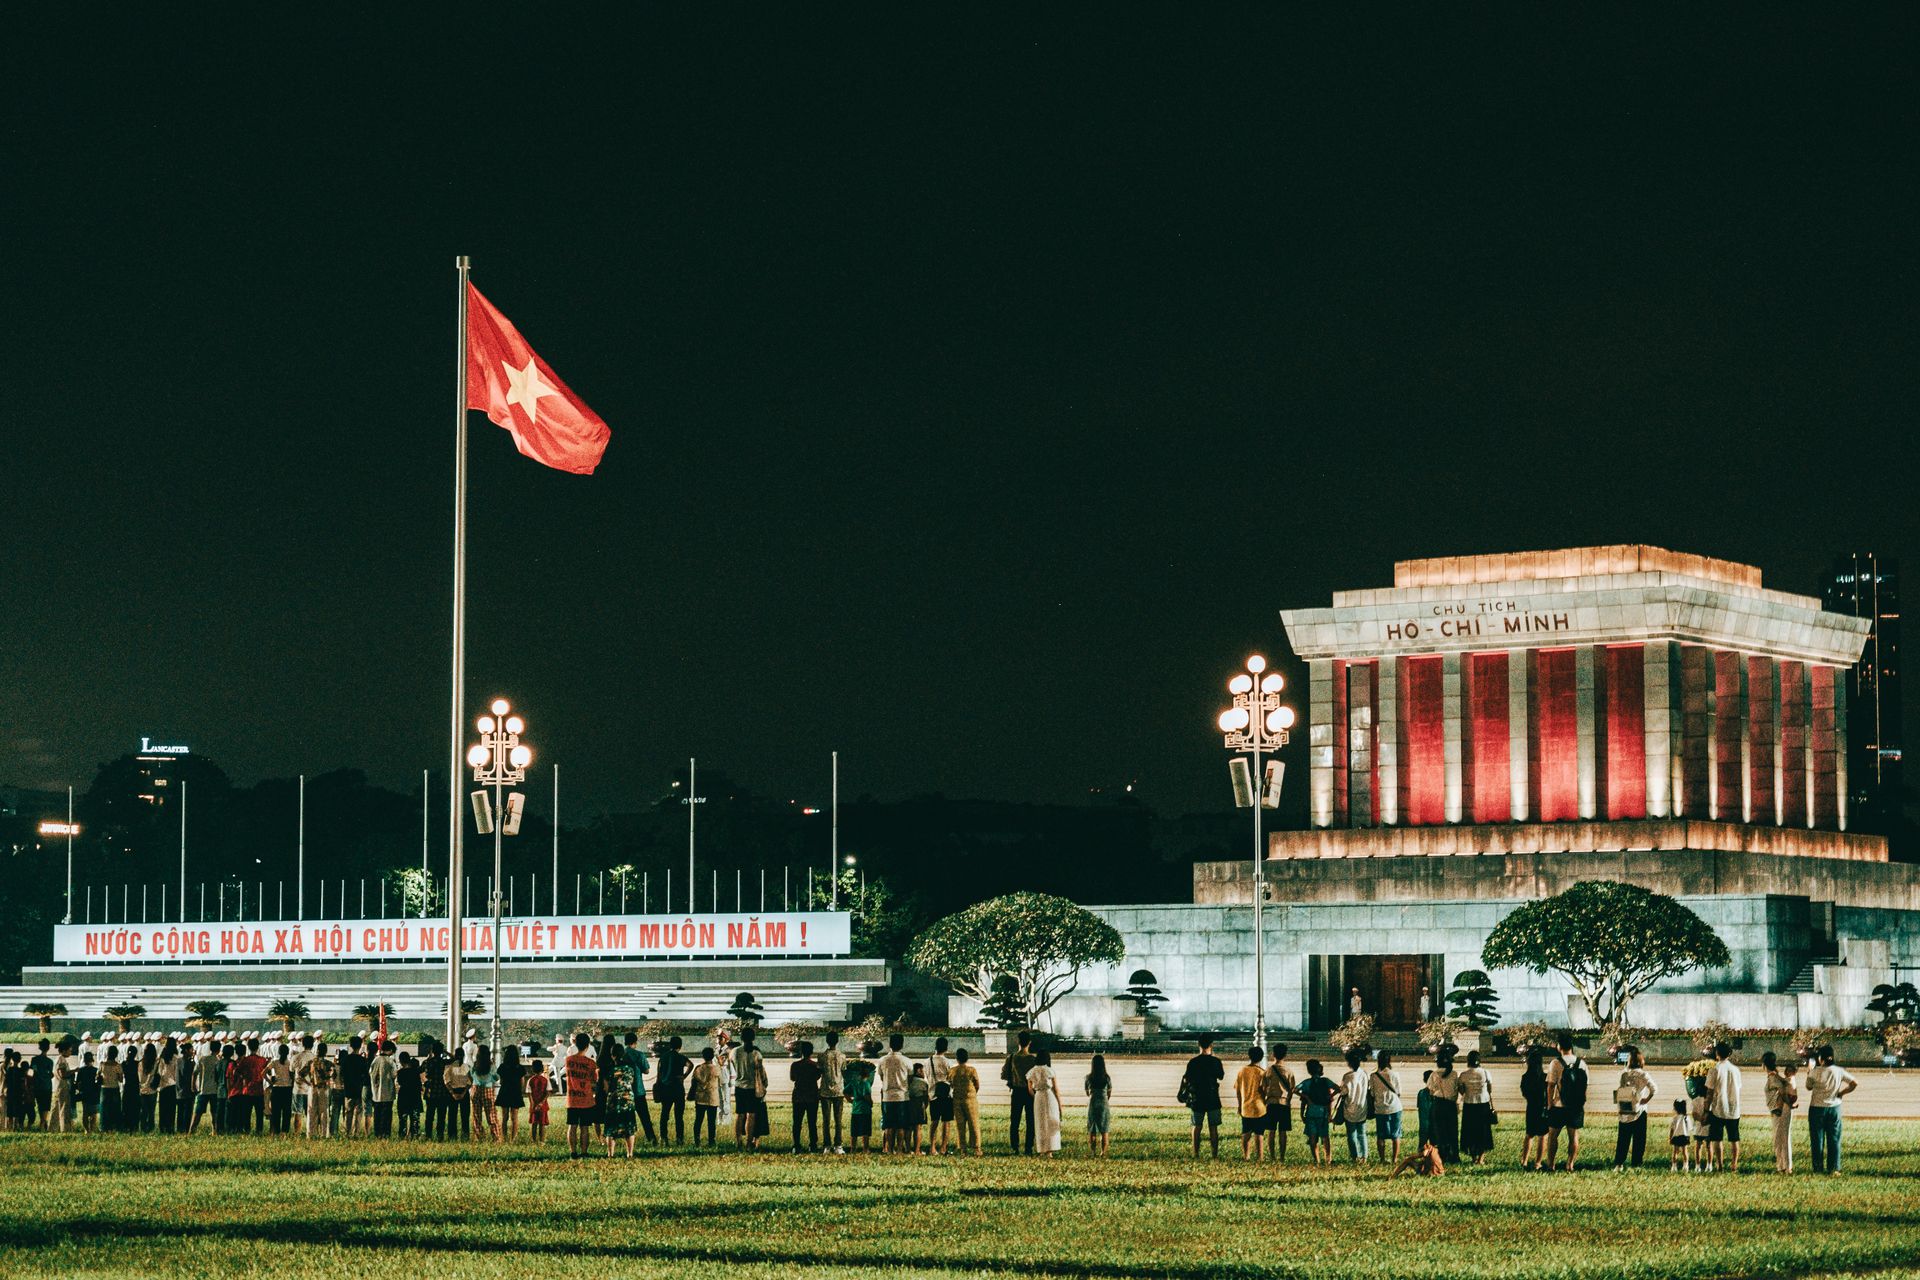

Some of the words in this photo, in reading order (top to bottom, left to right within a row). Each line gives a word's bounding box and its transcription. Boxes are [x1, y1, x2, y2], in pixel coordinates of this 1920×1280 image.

[85, 929, 142, 956] NƯỚC
[152, 927, 211, 959] CỘNG
[220, 924, 264, 954] HÒA
[274, 925, 303, 953] XÃ
[313, 925, 352, 956] HỘI
[363, 921, 409, 952] CHỦ
[506, 920, 559, 955] VIỆT
[571, 924, 627, 950] NAM
[639, 918, 715, 949] MUÔN
[727, 917, 787, 948] NĂM
[800, 921, 807, 948] !
